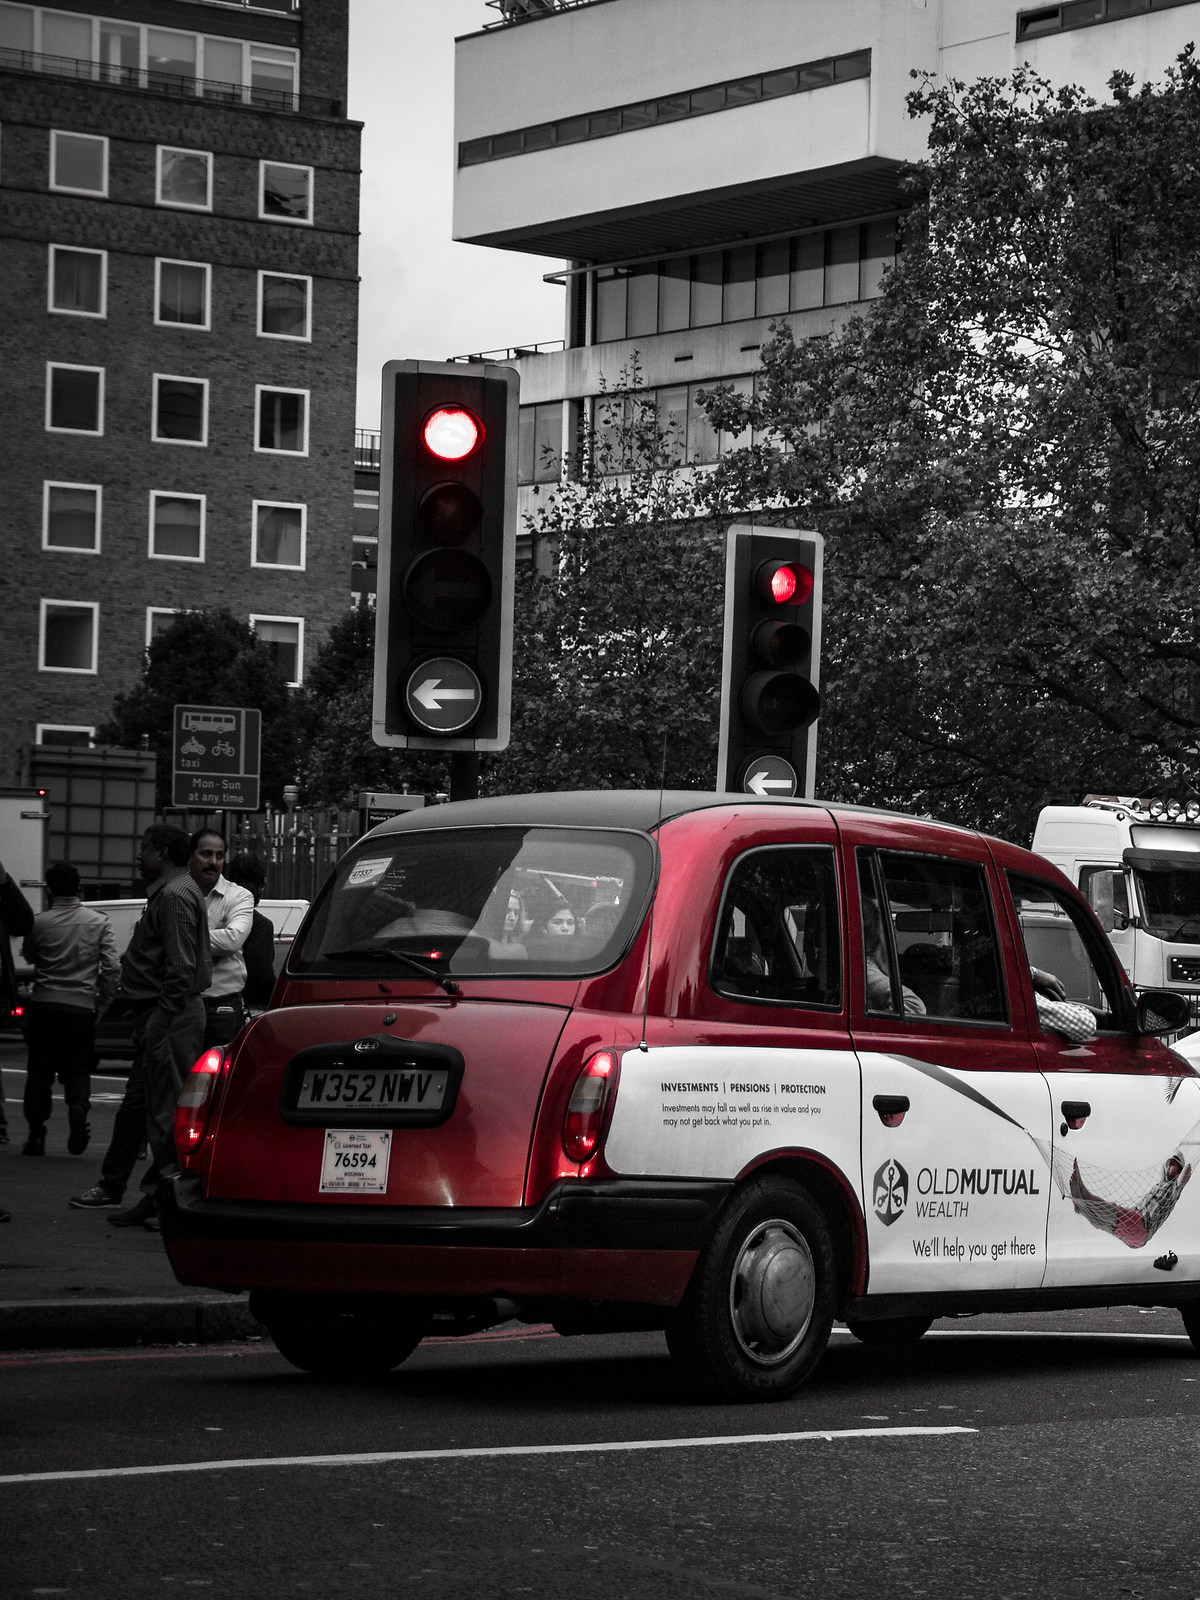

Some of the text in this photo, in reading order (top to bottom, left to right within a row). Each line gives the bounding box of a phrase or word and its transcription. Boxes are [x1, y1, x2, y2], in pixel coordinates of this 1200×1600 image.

[181, 757, 200, 768] taxi
[192, 778, 215, 789] Mon
[222, 779, 242, 790] Sun
[188, 792, 244, 804] at any time
[310, 1073, 433, 1103] W352 NWV
[661, 1083, 826, 1095] INVESTMENTS PENSIONS PROTECTION
[662, 1102, 822, 1116] Investments may fall as well as rise in value and you
[663, 1116, 772, 1128] may not get back what you put in.
[335, 1152, 377, 1168] 76594
[916, 1201, 969, 1218] WEALTH
[913, 1236, 1036, 1262] We'll help you get there
